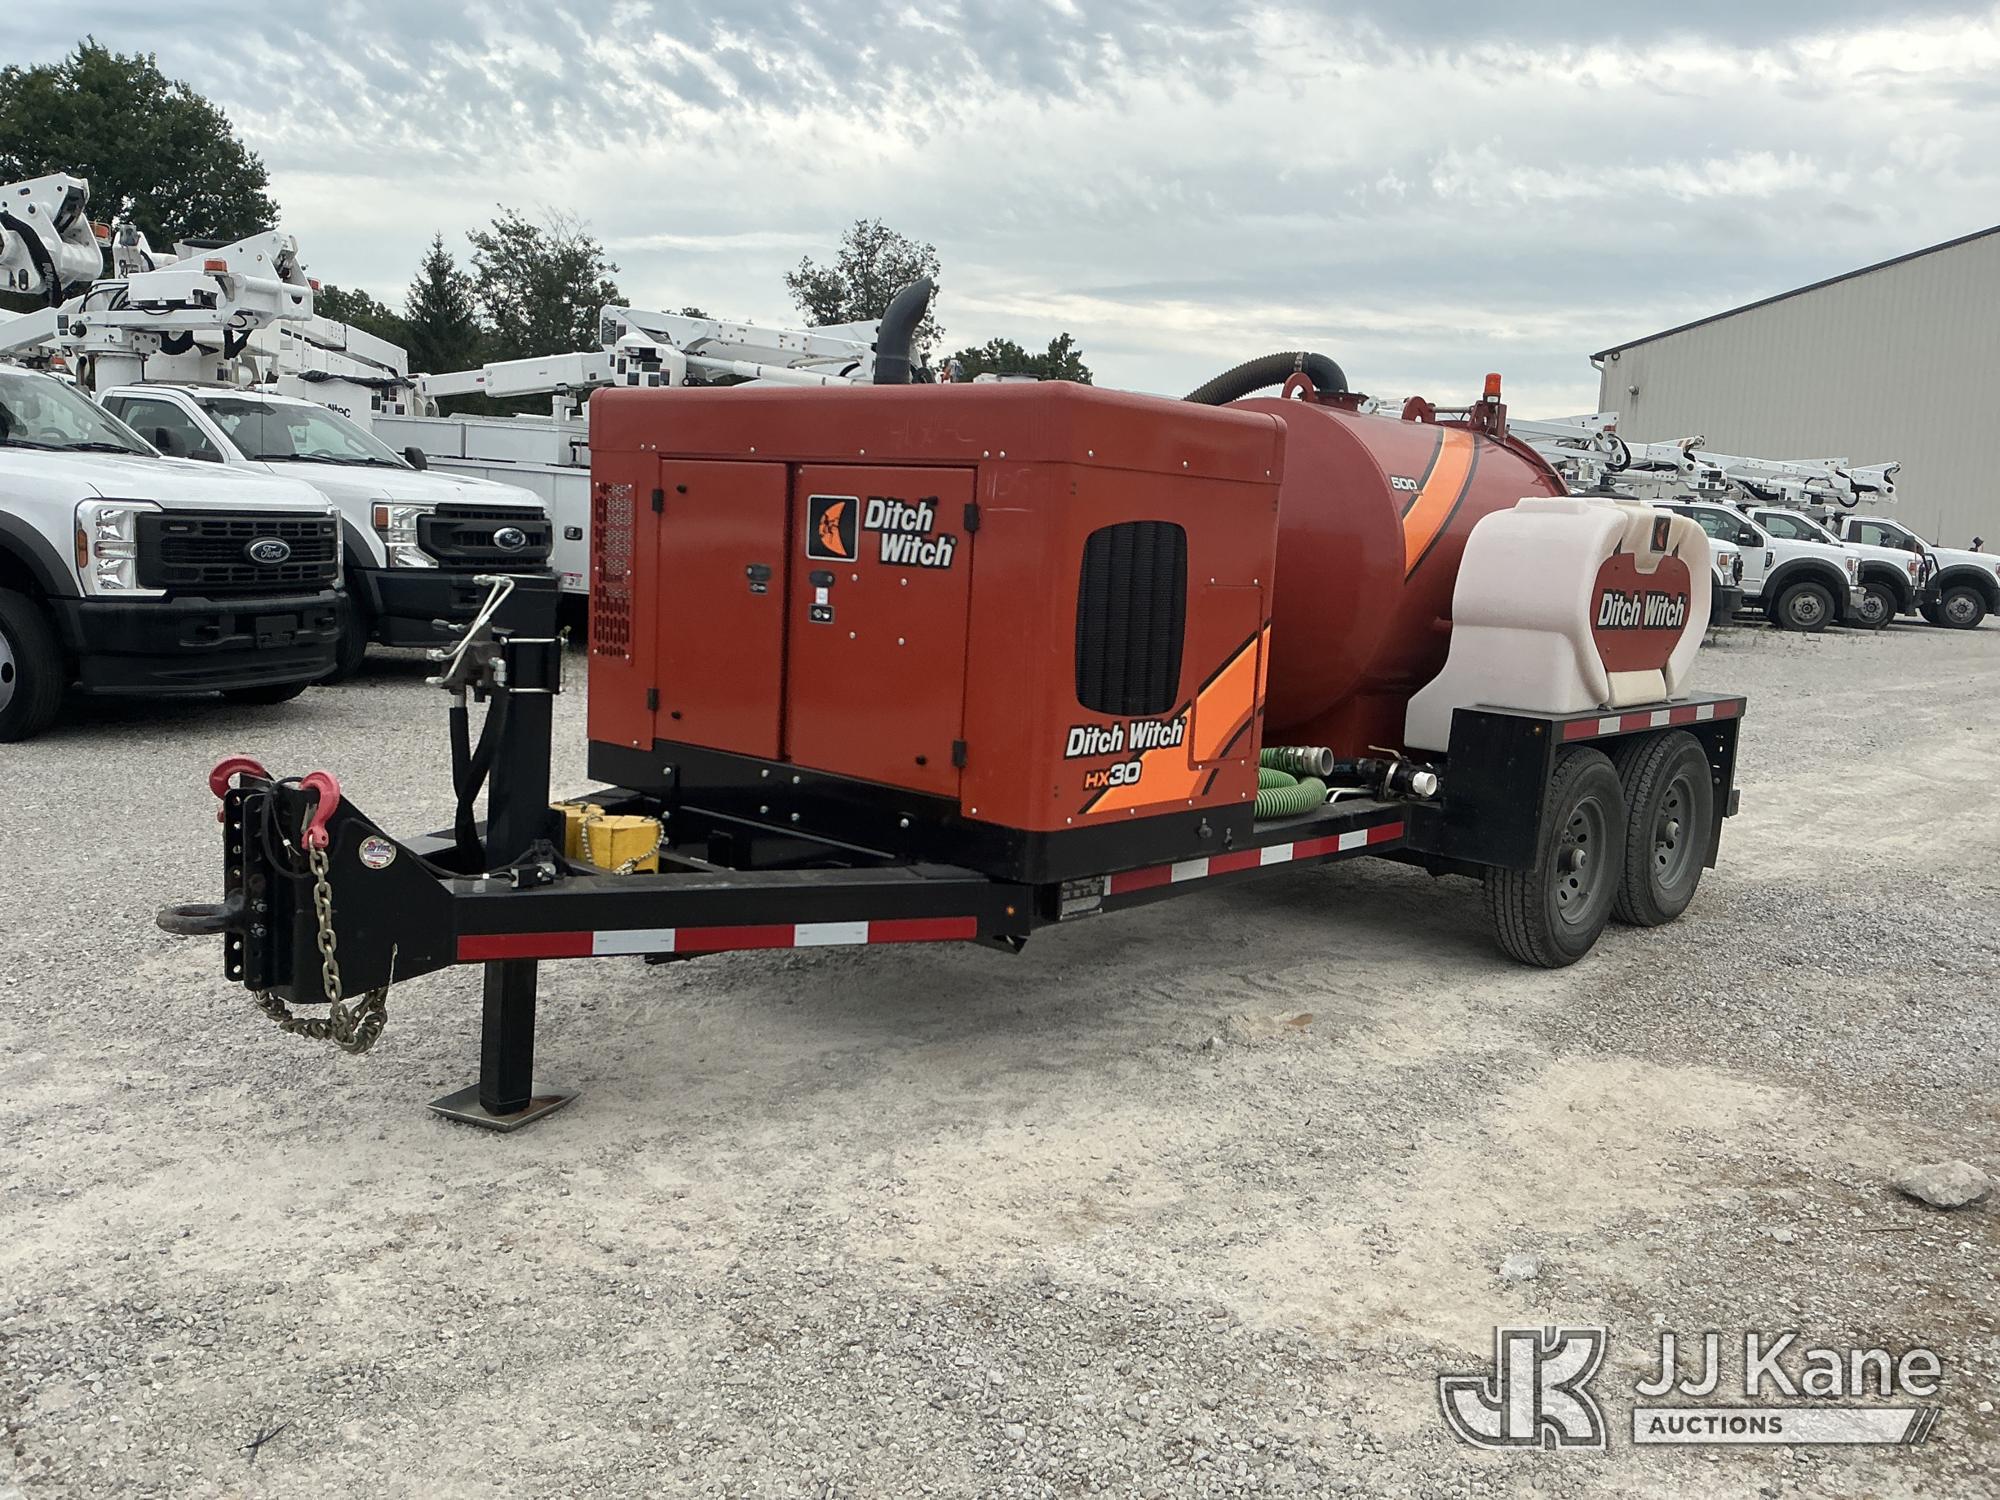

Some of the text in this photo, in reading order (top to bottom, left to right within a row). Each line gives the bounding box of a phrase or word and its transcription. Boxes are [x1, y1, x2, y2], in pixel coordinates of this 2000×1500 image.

[1391, 476, 1418, 490] 500
[864, 499, 934, 532] Ditch
[260, 544, 283, 558] Ford
[880, 532, 953, 567] Witch
[1597, 593, 1686, 627] Ditch Witch
[1065, 719, 1184, 757] Ditch Witch
[1084, 761, 1142, 788] HX30
